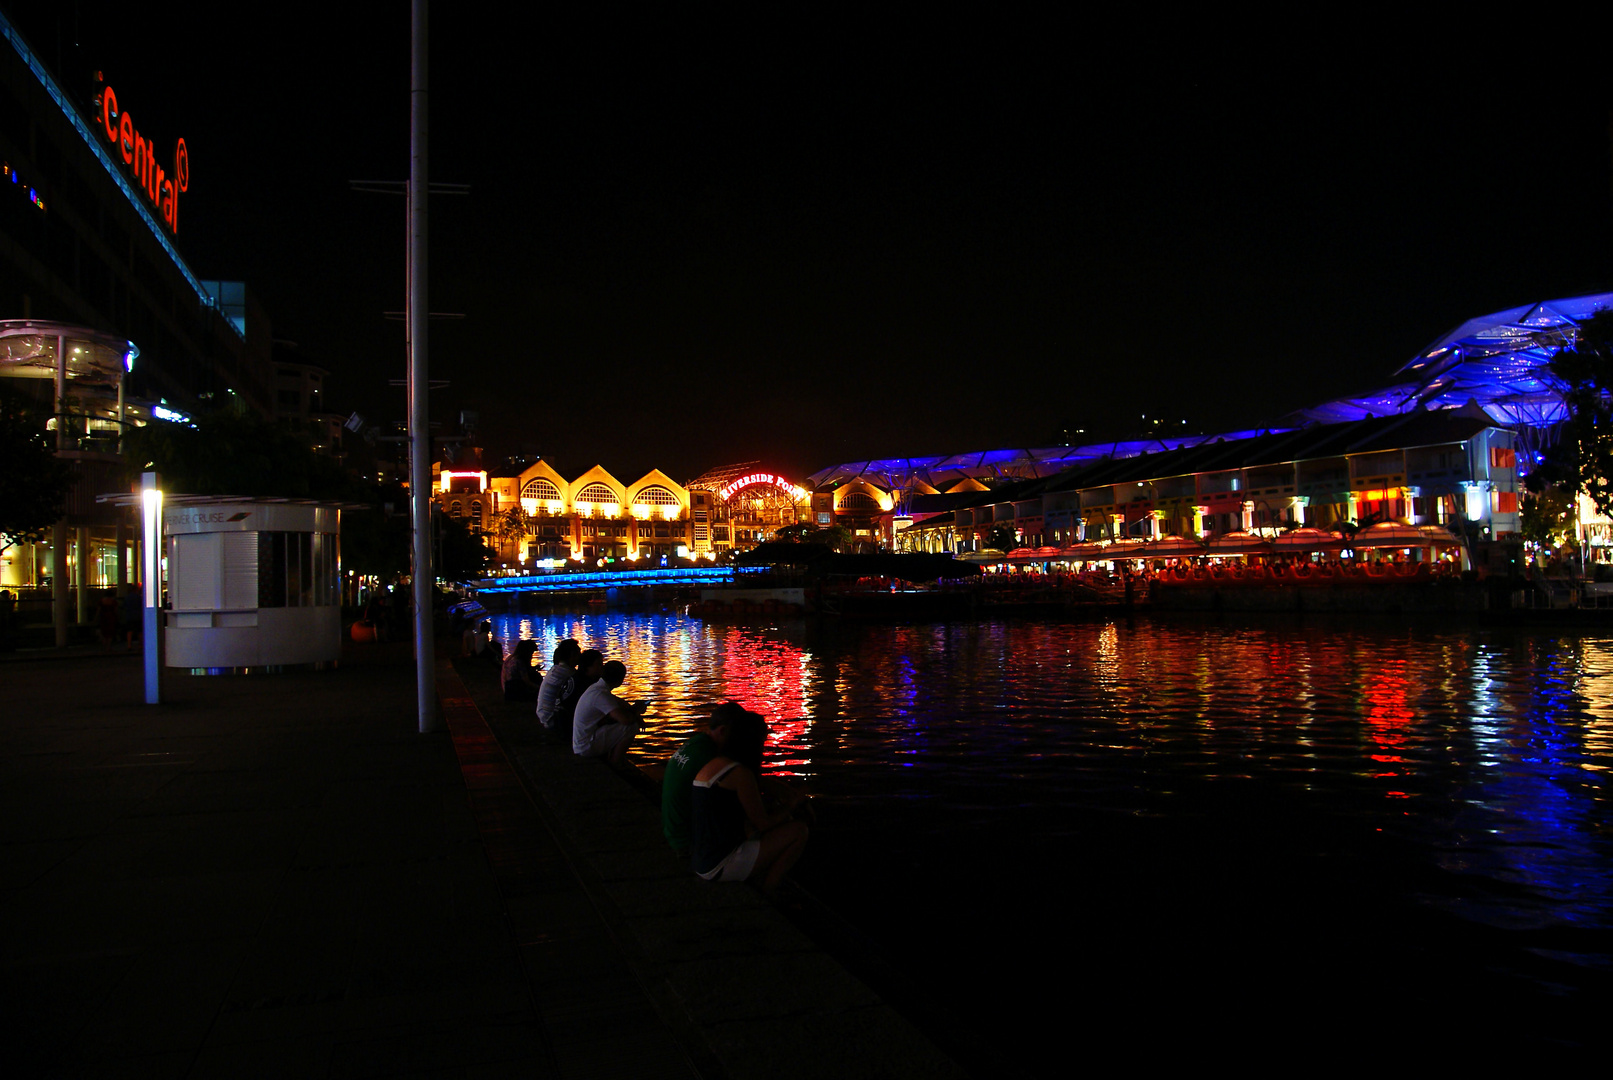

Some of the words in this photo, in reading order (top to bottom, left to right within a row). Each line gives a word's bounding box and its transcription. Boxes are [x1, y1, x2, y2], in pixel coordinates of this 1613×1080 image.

[103, 86, 178, 234] central
[720, 474, 774, 501] RIVERSIDE
[192, 512, 224, 524] CRUISE
